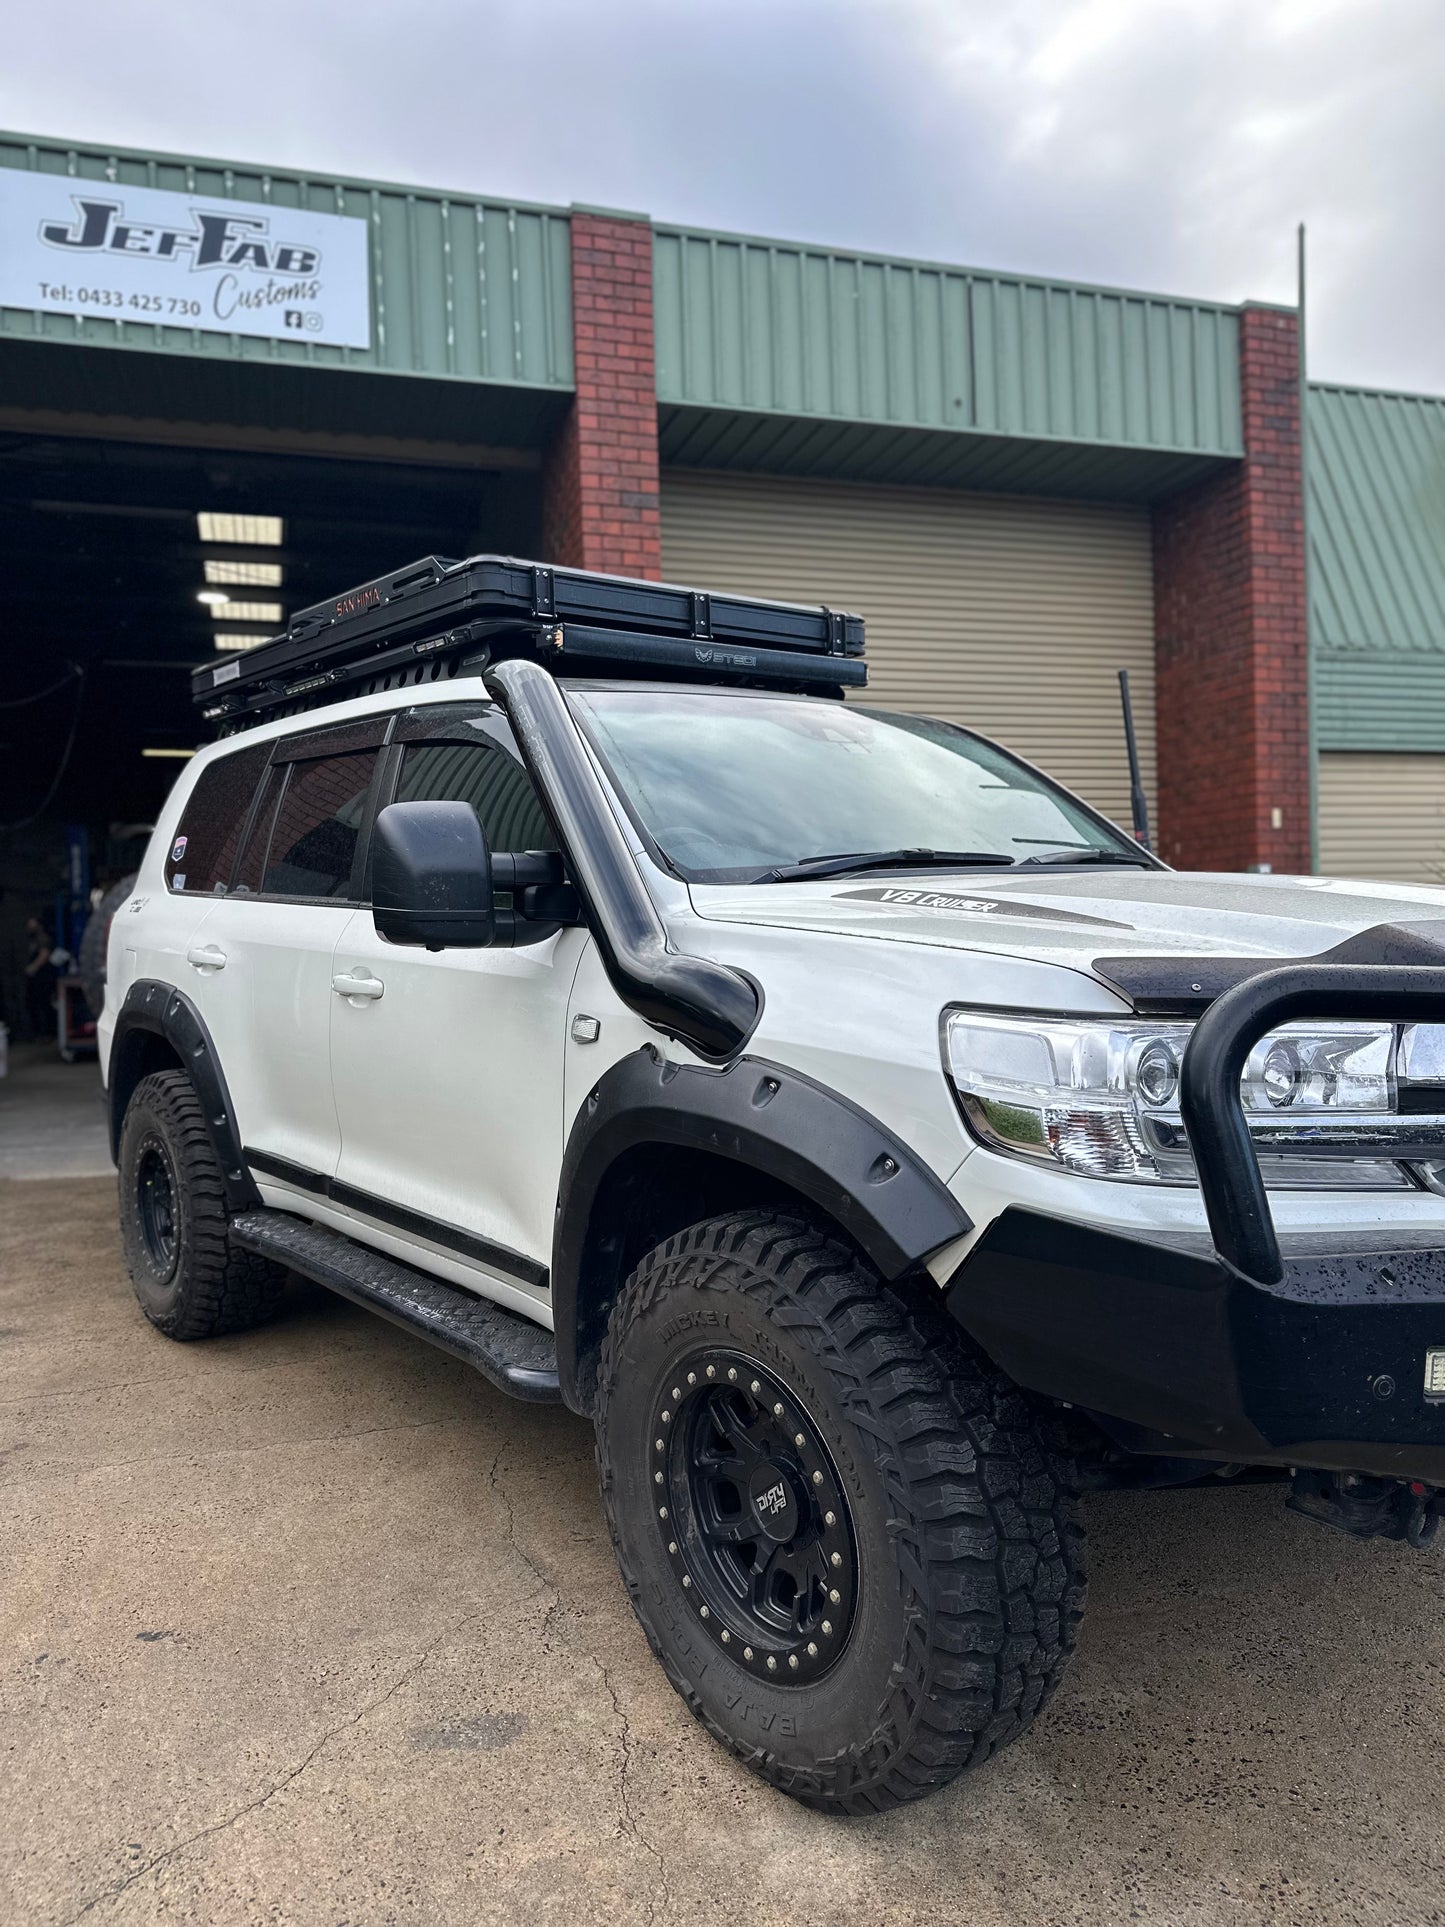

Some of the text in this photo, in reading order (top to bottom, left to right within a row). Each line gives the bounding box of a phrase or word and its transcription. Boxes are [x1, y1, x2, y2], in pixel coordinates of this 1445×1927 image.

[39, 283, 201, 316] Tel: 0433 425 730
[213, 273, 321, 320] Customs
[336, 599, 355, 617] SAN
[713, 652, 757, 667] STEDI
[880, 889, 999, 912] V8 CRUISER
[655, 1310, 730, 1346] MICKEY
[756, 1482, 785, 1512] DIRTY
